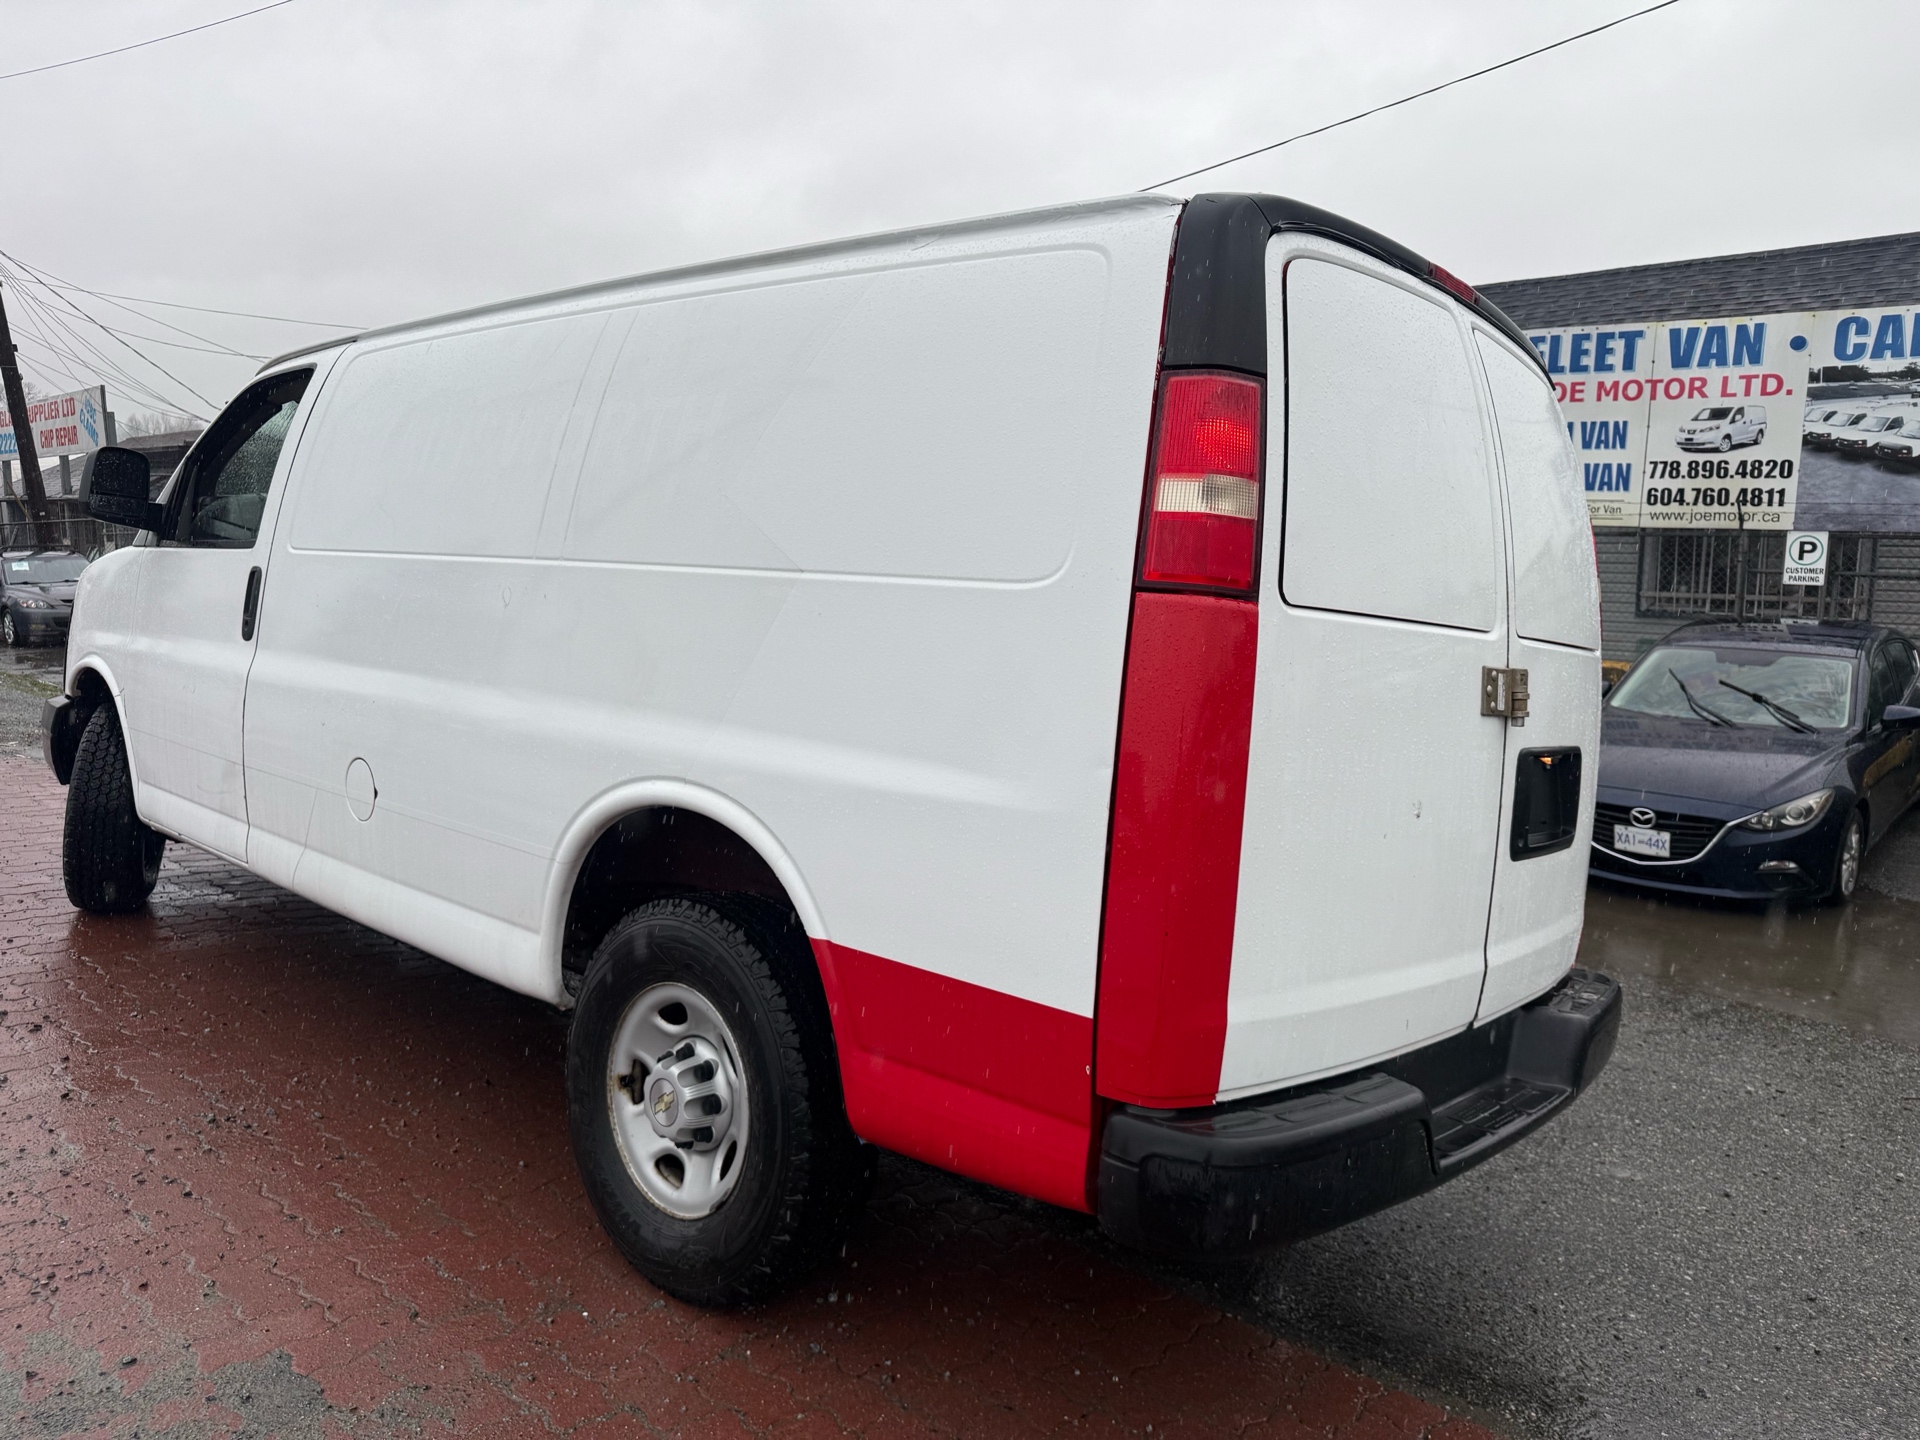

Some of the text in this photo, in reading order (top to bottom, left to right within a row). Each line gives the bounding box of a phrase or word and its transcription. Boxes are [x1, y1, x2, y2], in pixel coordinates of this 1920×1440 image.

[1669, 322, 1767, 370] VAN
[1596, 376, 1709, 402] MOTOR
[1720, 373, 1793, 398] LTD.
[61, 397, 76, 417] LTD
[40, 425, 79, 449] CHIP REPAIR
[1581, 420, 1628, 450] VAN
[1583, 462, 1632, 492] VAN
[1649, 459, 1794, 480] 778.896.4820
[1646, 487, 1786, 507] 604.760.4811
[1603, 504, 1622, 514] Van
[1649, 509, 1781, 524] www.joemoor.ca
[1798, 541, 1818, 561] P
[1785, 567, 1825, 575] CUSTOMER
[1788, 575, 1820, 583] PARKING
